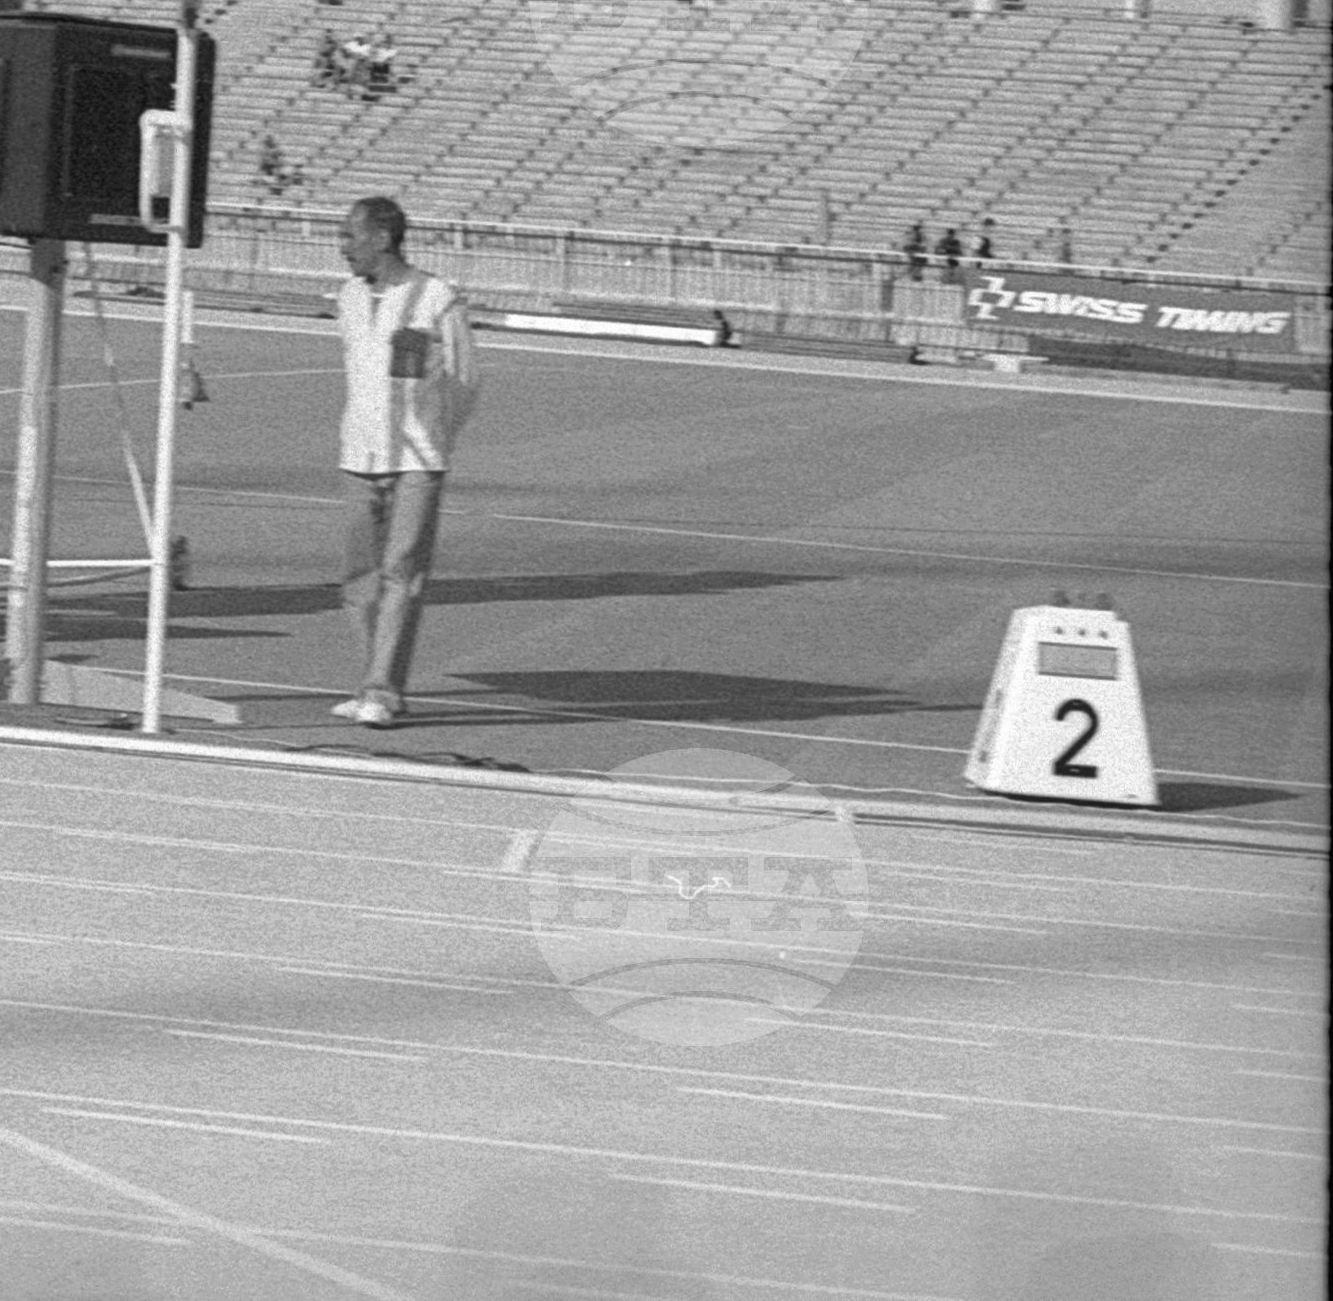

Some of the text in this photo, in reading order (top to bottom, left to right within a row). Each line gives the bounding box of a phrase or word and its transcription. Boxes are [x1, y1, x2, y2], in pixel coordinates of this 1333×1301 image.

[1013, 291, 1291, 334] SWISS TIMING
[1052, 699, 1099, 779] 2
